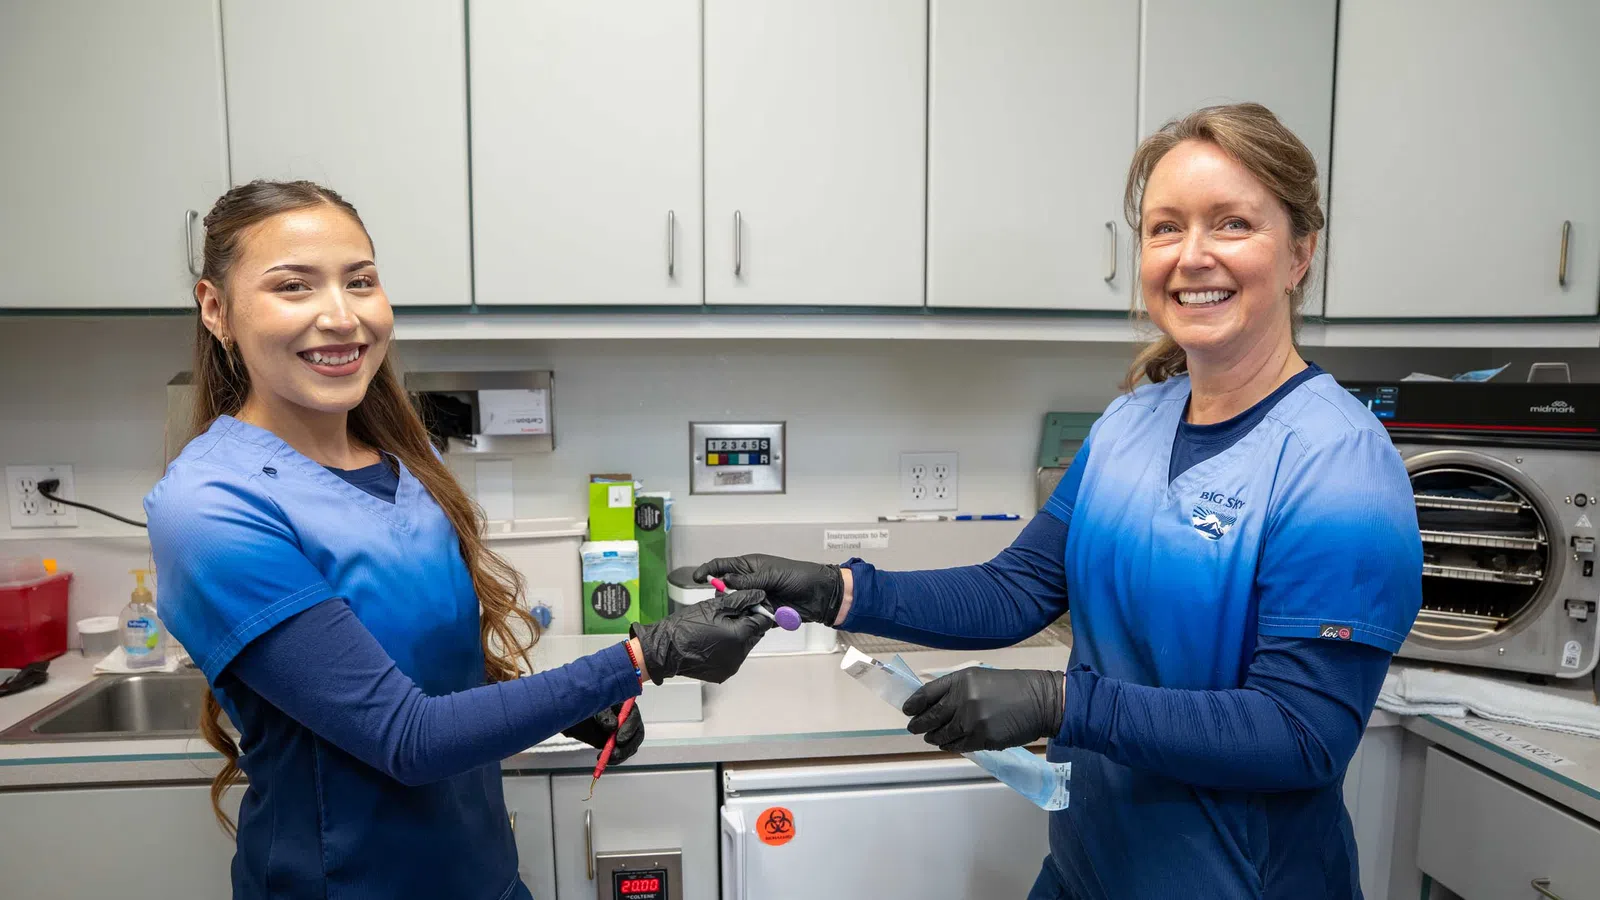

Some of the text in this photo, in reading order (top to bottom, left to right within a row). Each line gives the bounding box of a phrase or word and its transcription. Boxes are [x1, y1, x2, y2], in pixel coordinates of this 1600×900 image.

[1530, 405, 1575, 413] midmark
[760, 455, 768, 464] R
[1199, 491, 1225, 504] BIG
[1224, 497, 1246, 509] SKY
[827, 532, 869, 540] Instruments
[1322, 626, 1338, 638] koi
[1464, 720, 1564, 764] CLEAN AREA
